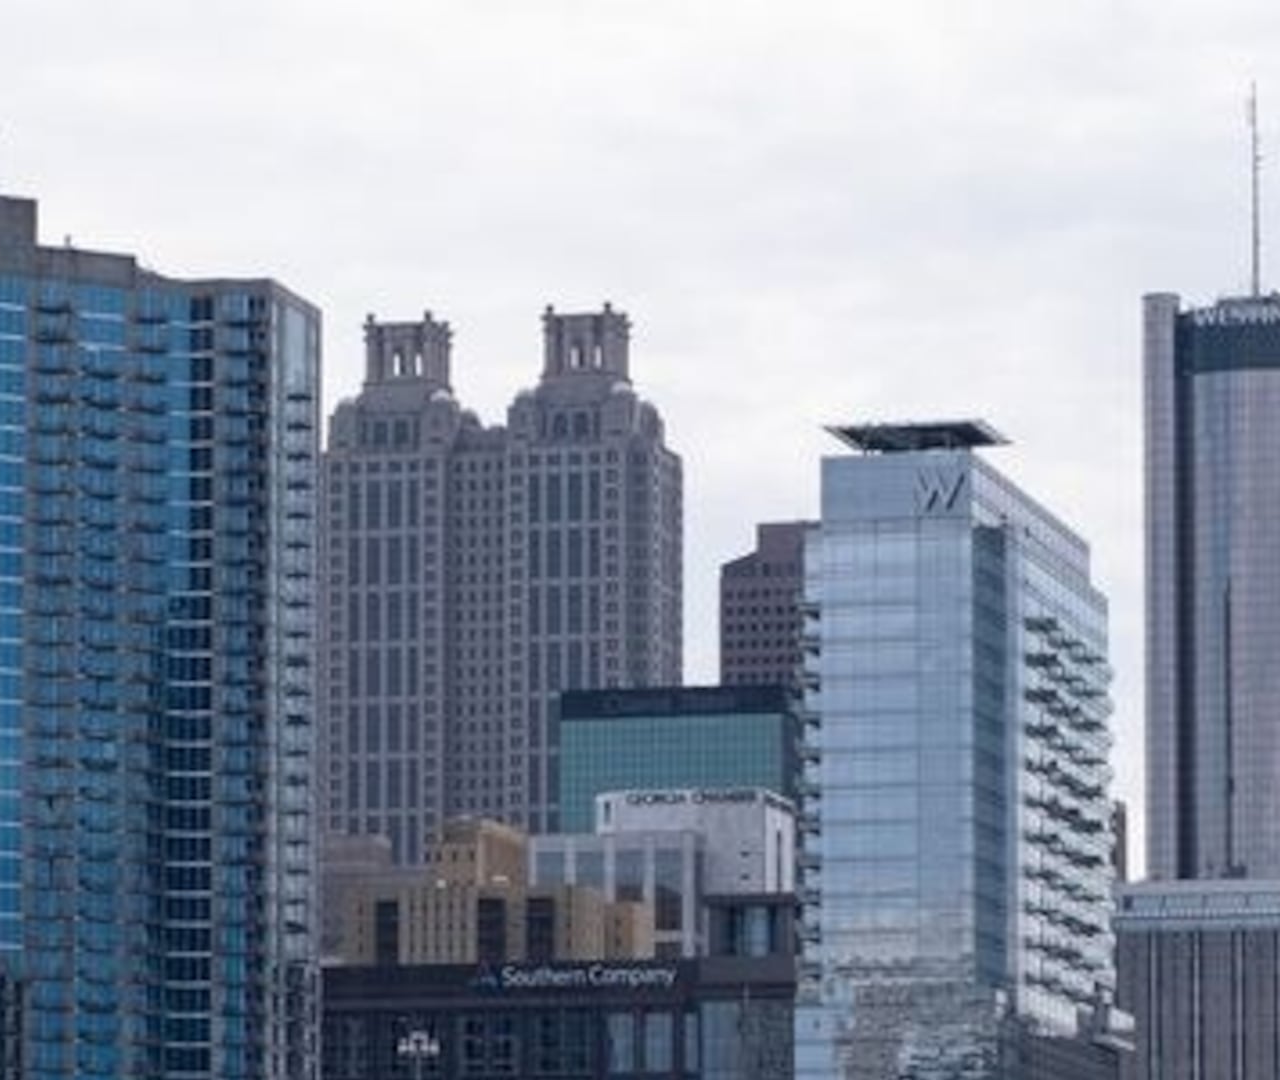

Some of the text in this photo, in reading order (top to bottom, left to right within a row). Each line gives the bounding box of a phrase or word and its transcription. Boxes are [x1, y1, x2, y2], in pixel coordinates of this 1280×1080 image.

[914, 466, 965, 511] W
[502, 963, 677, 987] Southern Company
